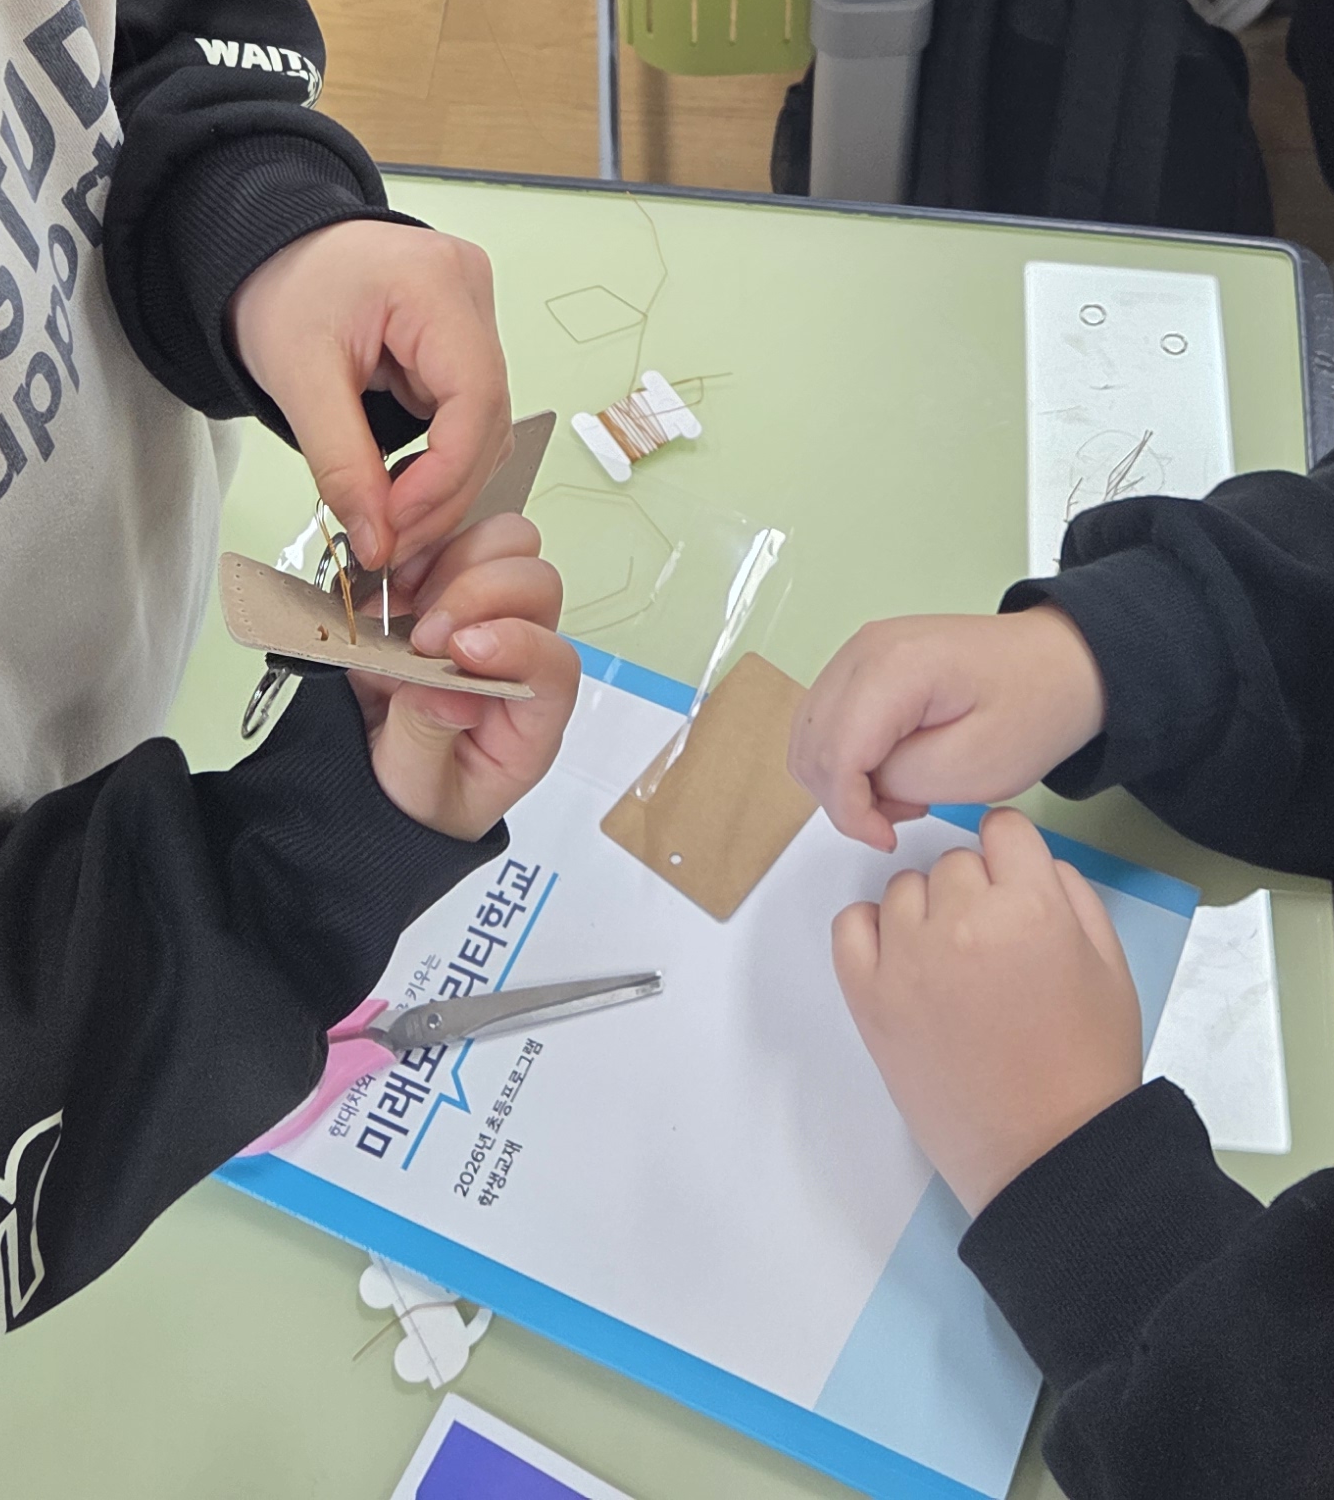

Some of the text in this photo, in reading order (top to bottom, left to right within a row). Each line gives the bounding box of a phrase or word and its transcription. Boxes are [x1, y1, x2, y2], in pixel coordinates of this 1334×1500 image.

[355, 858, 541, 1160] 미래모리티학교
[404, 953, 442, 1003] 키우는
[328, 1072, 377, 1138] 현대차와
[453, 1037, 544, 1198] 2026년 초등프로그램
[477, 1138, 524, 1207] 학생교재
